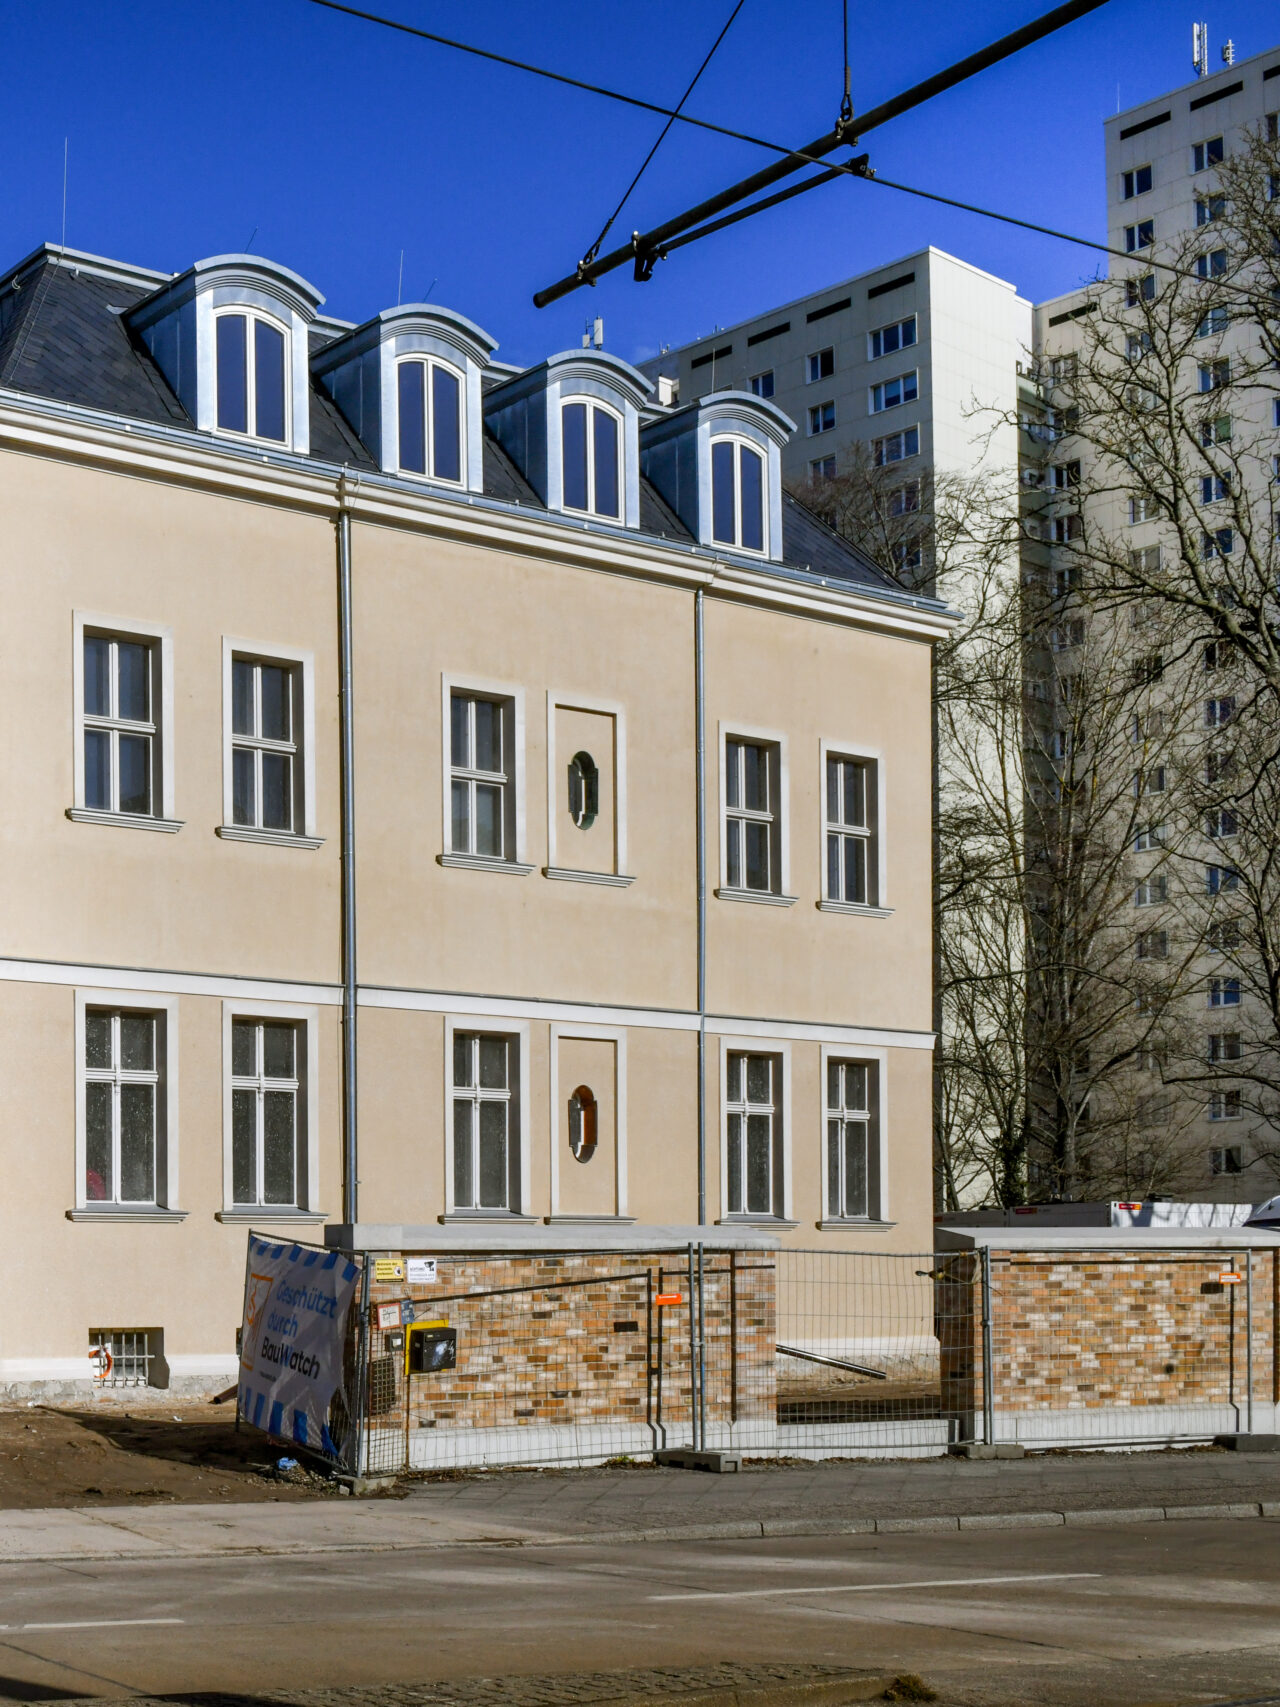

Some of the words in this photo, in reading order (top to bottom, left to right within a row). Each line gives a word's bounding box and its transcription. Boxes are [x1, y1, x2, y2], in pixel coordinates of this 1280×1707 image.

[276, 1280, 338, 1319] Geschützt
[267, 1311, 298, 1338] durch
[261, 1336, 320, 1380] BauWatch
